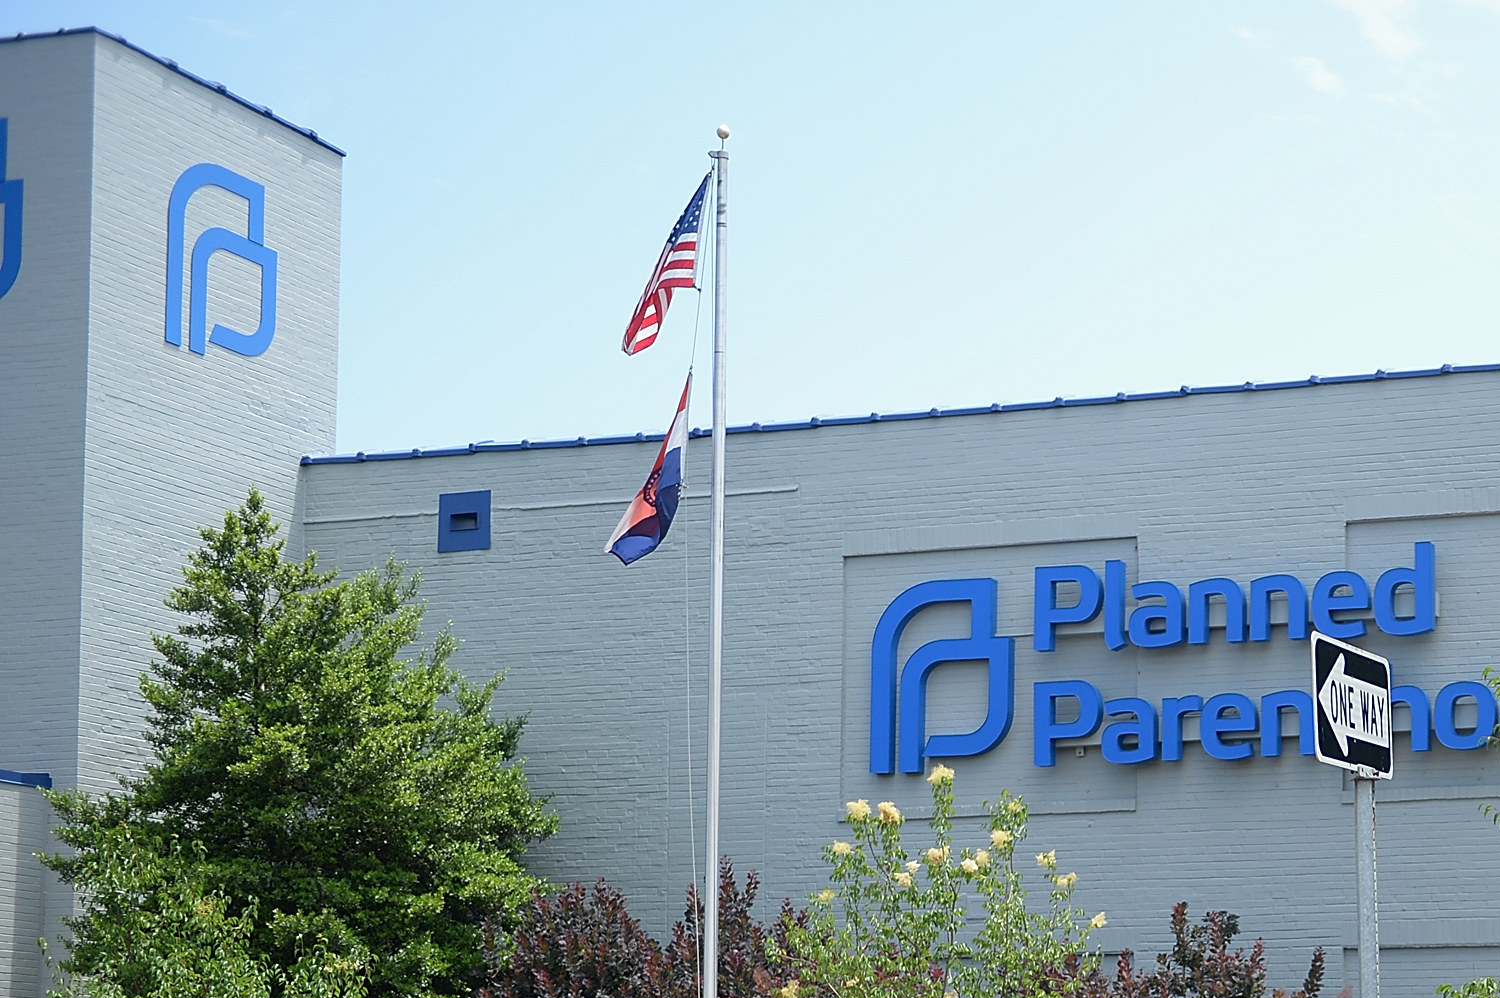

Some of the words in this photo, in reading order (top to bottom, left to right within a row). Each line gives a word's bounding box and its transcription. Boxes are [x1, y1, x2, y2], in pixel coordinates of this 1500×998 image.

[1033, 541, 1436, 652] Planned
[1330, 680, 1355, 729] ONE
[1360, 690, 1385, 739] WAY
